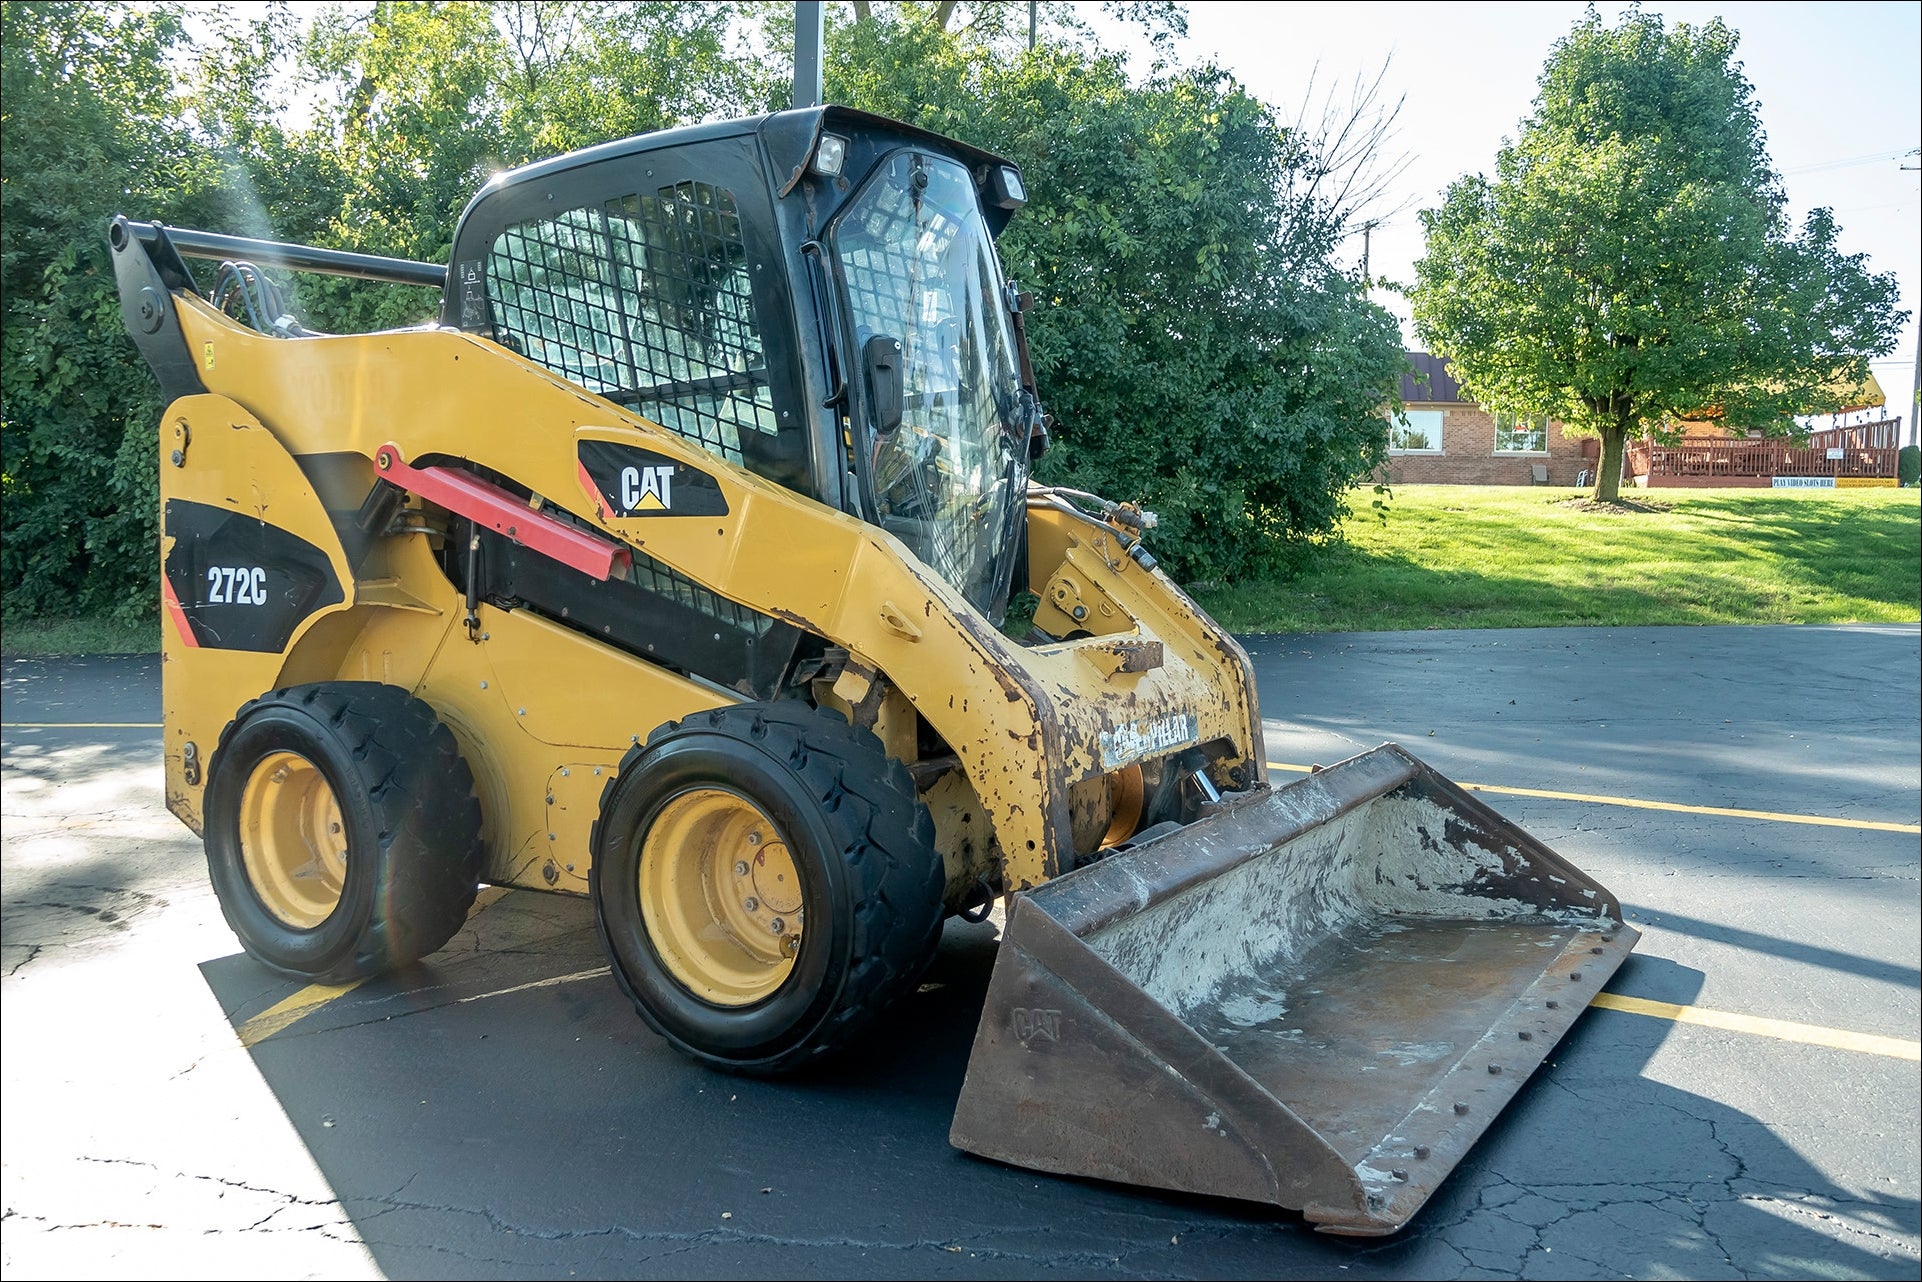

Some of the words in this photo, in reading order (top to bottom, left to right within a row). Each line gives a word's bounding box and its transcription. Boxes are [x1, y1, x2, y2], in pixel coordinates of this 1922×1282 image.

[621, 466, 674, 510] CAT
[1773, 479, 1786, 487] PLAY
[1787, 479, 1803, 487] VIDEO
[1803, 479, 1819, 487] SLOTS
[1820, 479, 1834, 487] HERE
[208, 566, 267, 606] 272C
[1012, 1007, 1062, 1042] CAT
